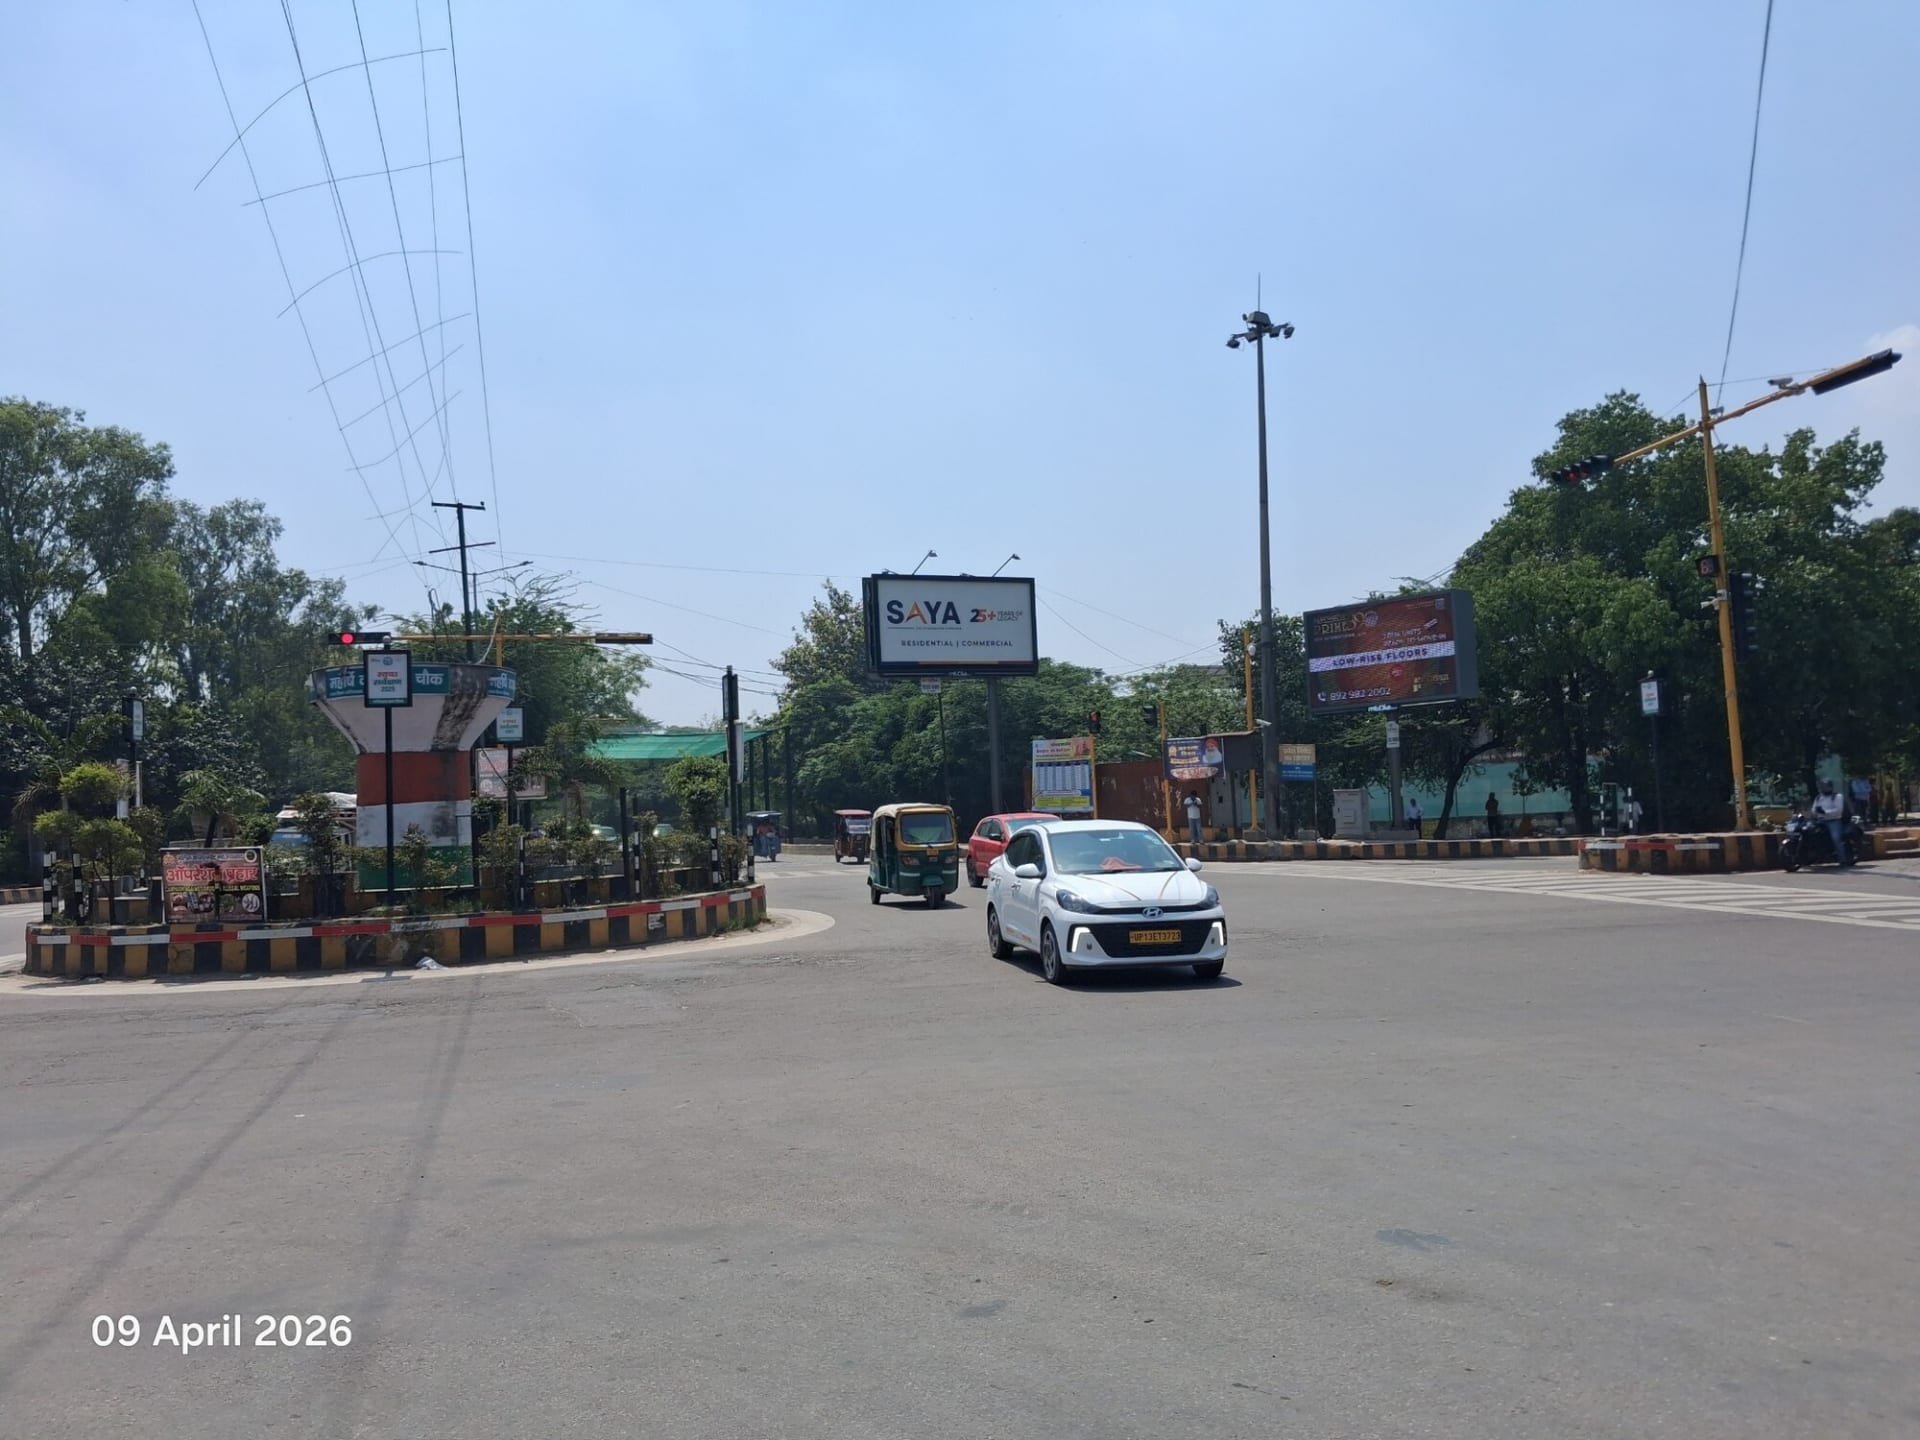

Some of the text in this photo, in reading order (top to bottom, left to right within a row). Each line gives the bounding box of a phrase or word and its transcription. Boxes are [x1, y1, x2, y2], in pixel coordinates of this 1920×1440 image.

[886, 600, 996, 624] SAYA 25+
[1333, 648, 1427, 666] LOW-RISE FLOORS
[415, 669, 444, 687] चौक
